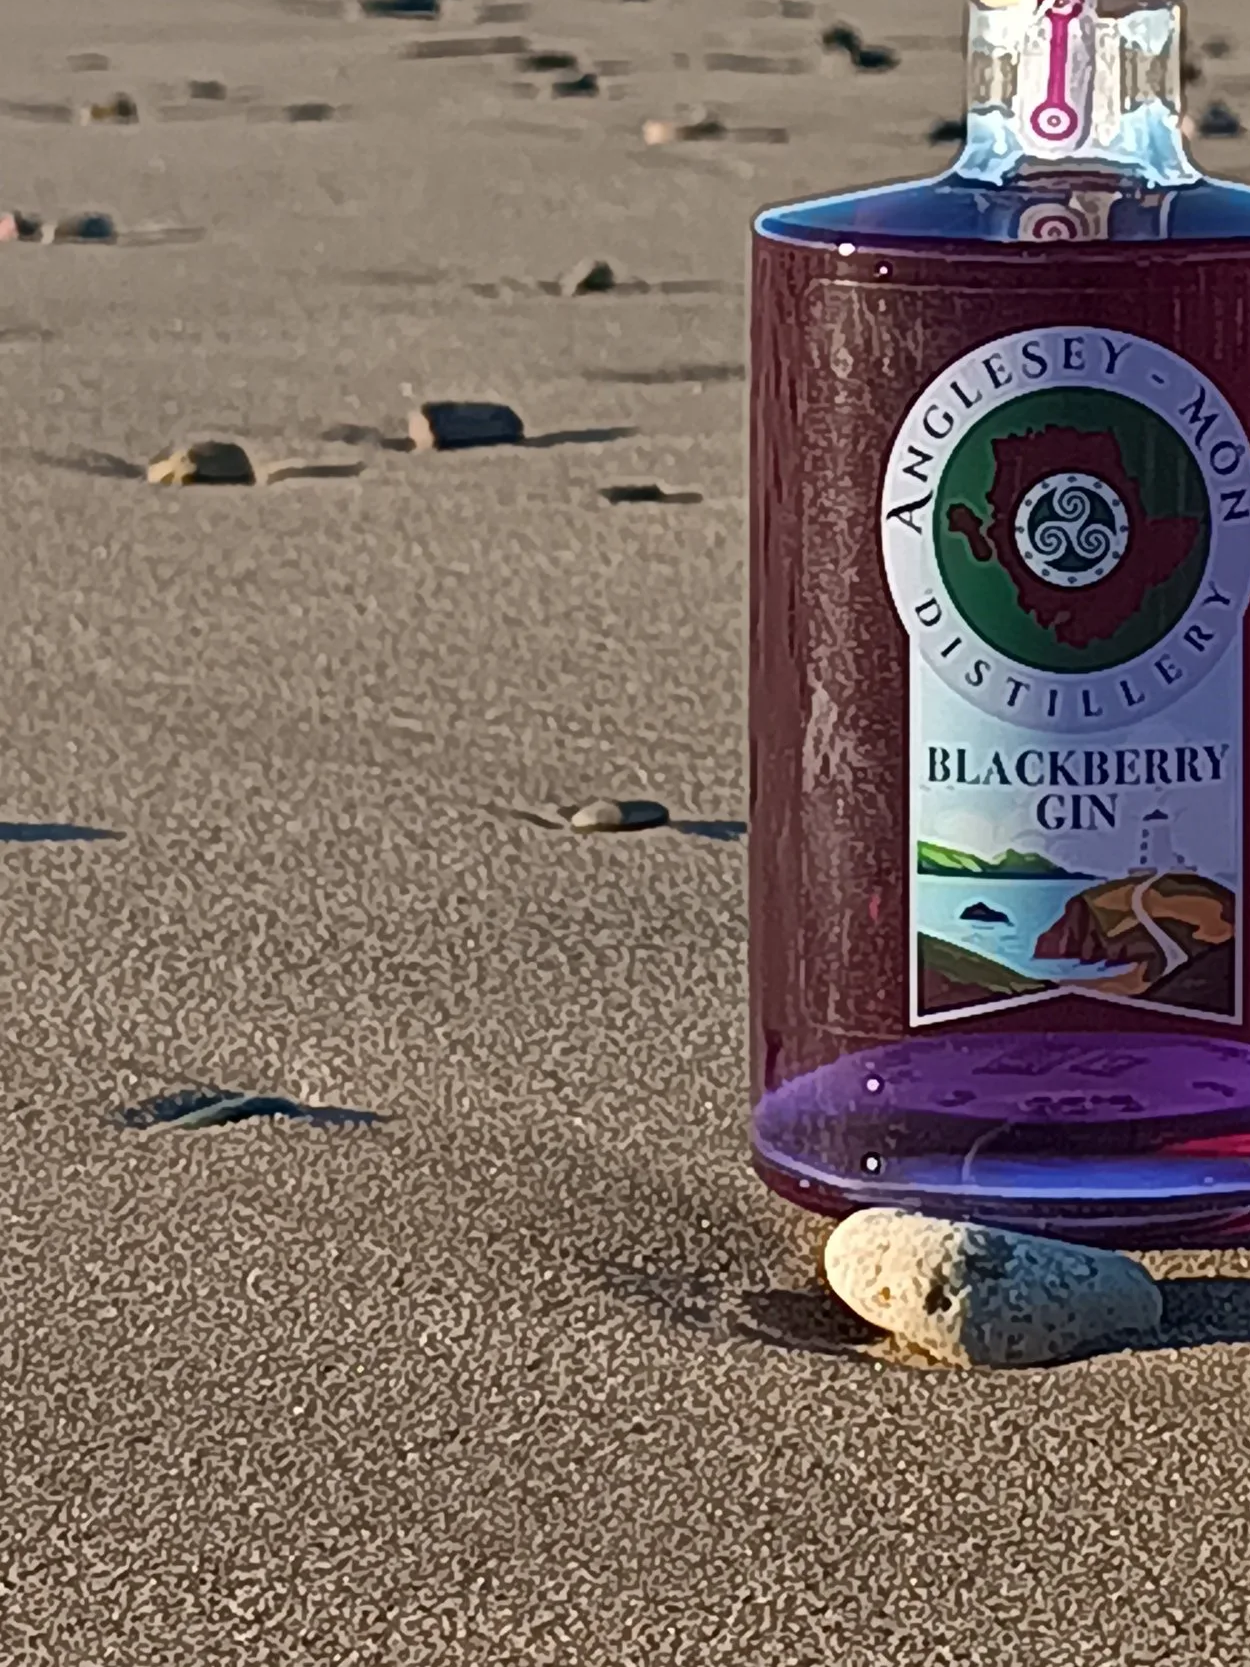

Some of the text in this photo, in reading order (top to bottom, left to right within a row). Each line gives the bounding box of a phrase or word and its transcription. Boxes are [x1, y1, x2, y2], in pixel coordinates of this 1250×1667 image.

[885, 335, 1133, 536] ANGLESEY
[914, 579, 1233, 717] DISTILLERY
[927, 743, 1230, 787] BLACKBERRY
[1035, 792, 1119, 831] GIN
